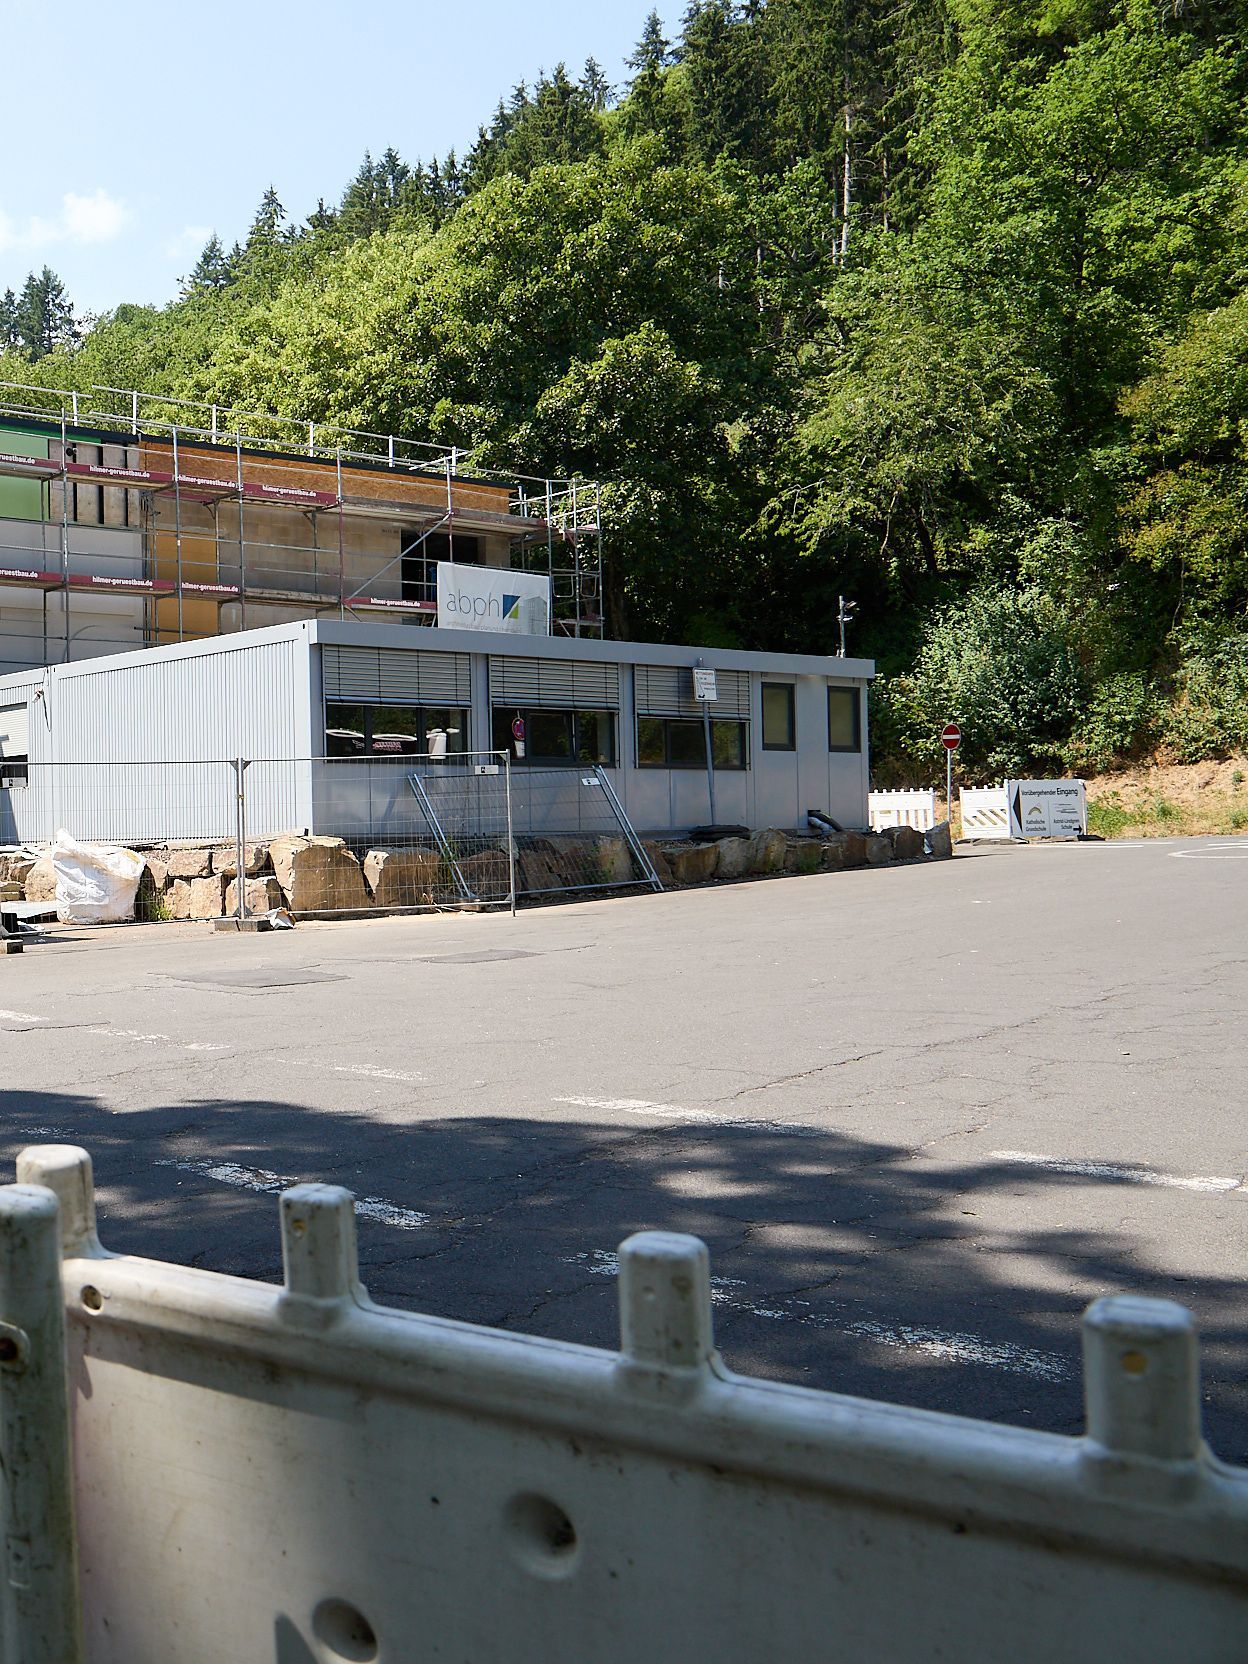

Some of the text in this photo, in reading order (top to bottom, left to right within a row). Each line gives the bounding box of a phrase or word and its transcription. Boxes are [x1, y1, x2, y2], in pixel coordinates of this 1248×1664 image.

[89, 465, 150, 478] hilmer-geruestbau.de
[92, 575, 153, 588] hilmer-geruestbau.de
[447, 589, 500, 621] abph
[1056, 788, 1078, 797] Eingang
